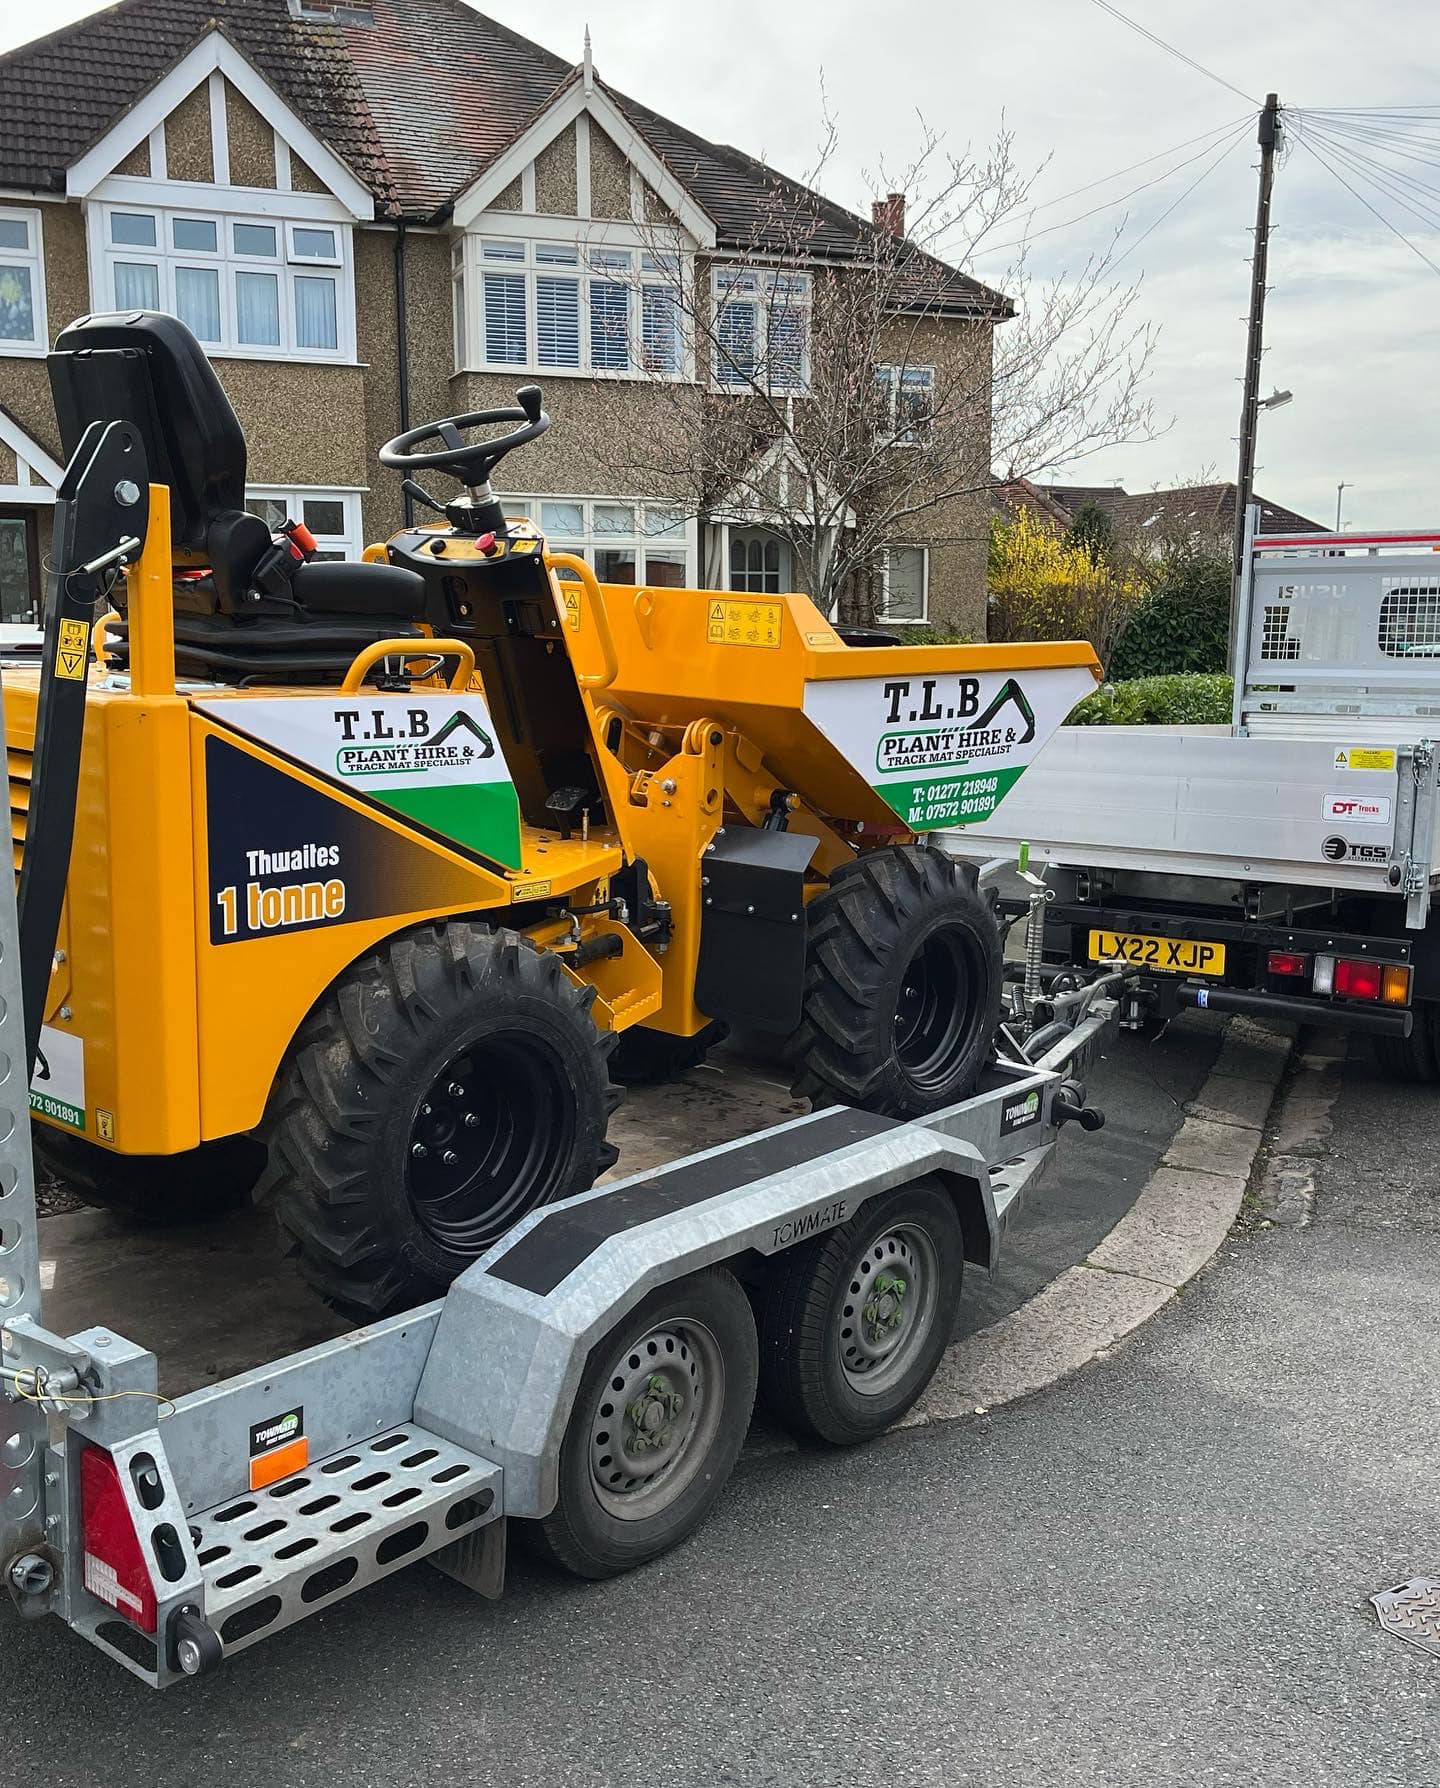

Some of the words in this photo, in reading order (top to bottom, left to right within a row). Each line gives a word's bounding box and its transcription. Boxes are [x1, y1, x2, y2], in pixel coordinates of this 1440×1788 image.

[883, 678, 980, 724] T.L.B
[334, 709, 430, 741] T.L.B
[343, 749, 409, 764] PLANT
[415, 746, 458, 760] HIRE
[462, 745, 475, 757] &
[883, 733, 954, 756] PLANT
[957, 729, 1002, 749] HIRE
[1005, 727, 1017, 743] &
[348, 762, 386, 772] TRACK
[388, 761, 412, 770] MAT
[414, 758, 472, 768] SPECIALIST
[887, 754, 926, 767] TRACK
[929, 751, 954, 763] MAT
[955, 744, 1012, 760] SPECIALIST
[912, 788, 925, 803] T:
[927, 783, 961, 801] 01277
[961, 776, 998, 797] 218948
[907, 806, 925, 823] M:
[926, 801, 958, 820] 07572
[959, 795, 996, 815] 901891
[1359, 805, 1380, 814] Trucks
[246, 843, 340, 876] Thwaites
[1349, 845, 1387, 858] TGS
[217, 886, 238, 935] 1
[247, 879, 346, 930] tonne
[1098, 934, 1160, 964] LX22
[1167, 942, 1215, 969] XJP
[44, 1099, 80, 1126] 901891
[772, 1200, 846, 1247] TOWMATE
[255, 1421, 296, 1443] TOWMATE
